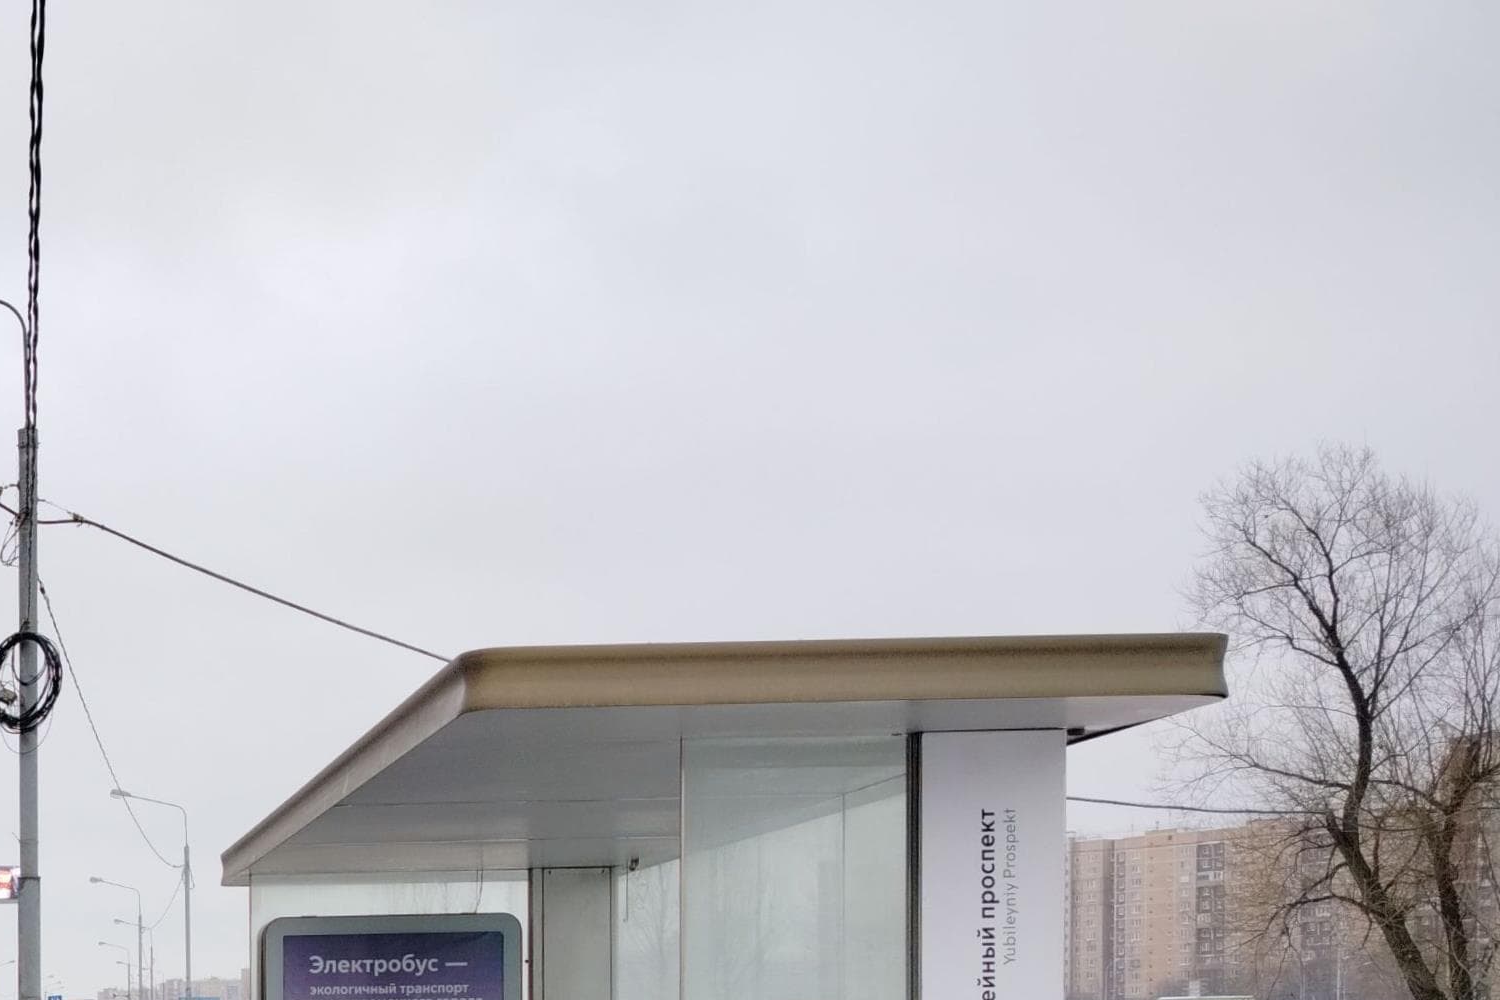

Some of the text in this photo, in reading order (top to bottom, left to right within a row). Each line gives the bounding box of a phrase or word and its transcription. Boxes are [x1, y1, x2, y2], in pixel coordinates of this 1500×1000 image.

[981, 808, 1001, 919] проспект
[1002, 808, 1020, 966] Yubileyniy Prospekt
[309, 953, 439, 977] Электробус
[309, 983, 469, 997] экологичный транспорт
